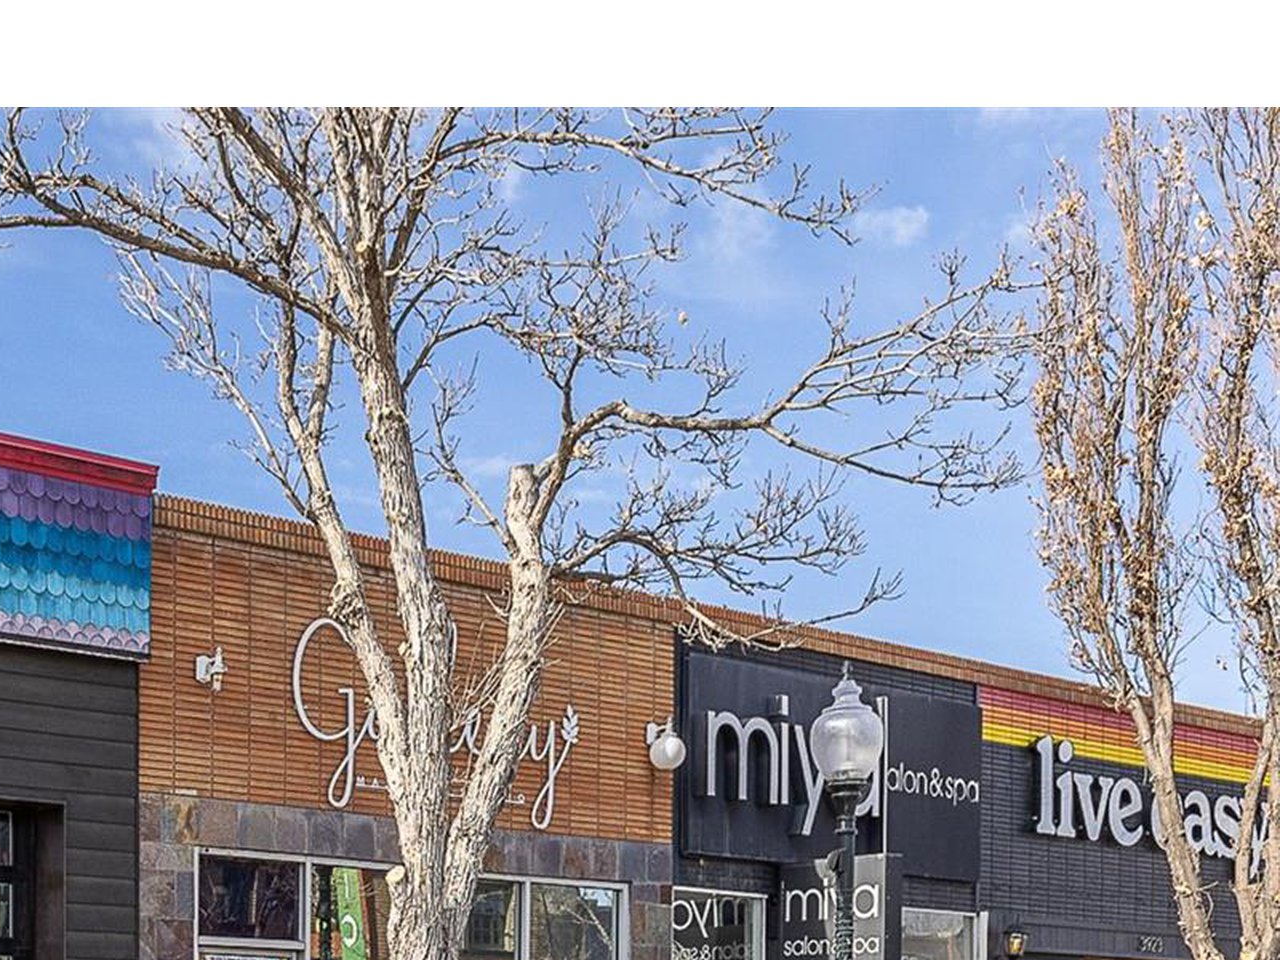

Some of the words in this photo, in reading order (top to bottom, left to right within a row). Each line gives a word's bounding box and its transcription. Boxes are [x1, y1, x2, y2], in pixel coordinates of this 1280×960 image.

[706, 694, 880, 836] miy
[886, 761, 980, 805] alon&spa
[1036, 735, 1144, 847] live
[784, 877, 880, 922] mia
[783, 934, 880, 957] salonpa
